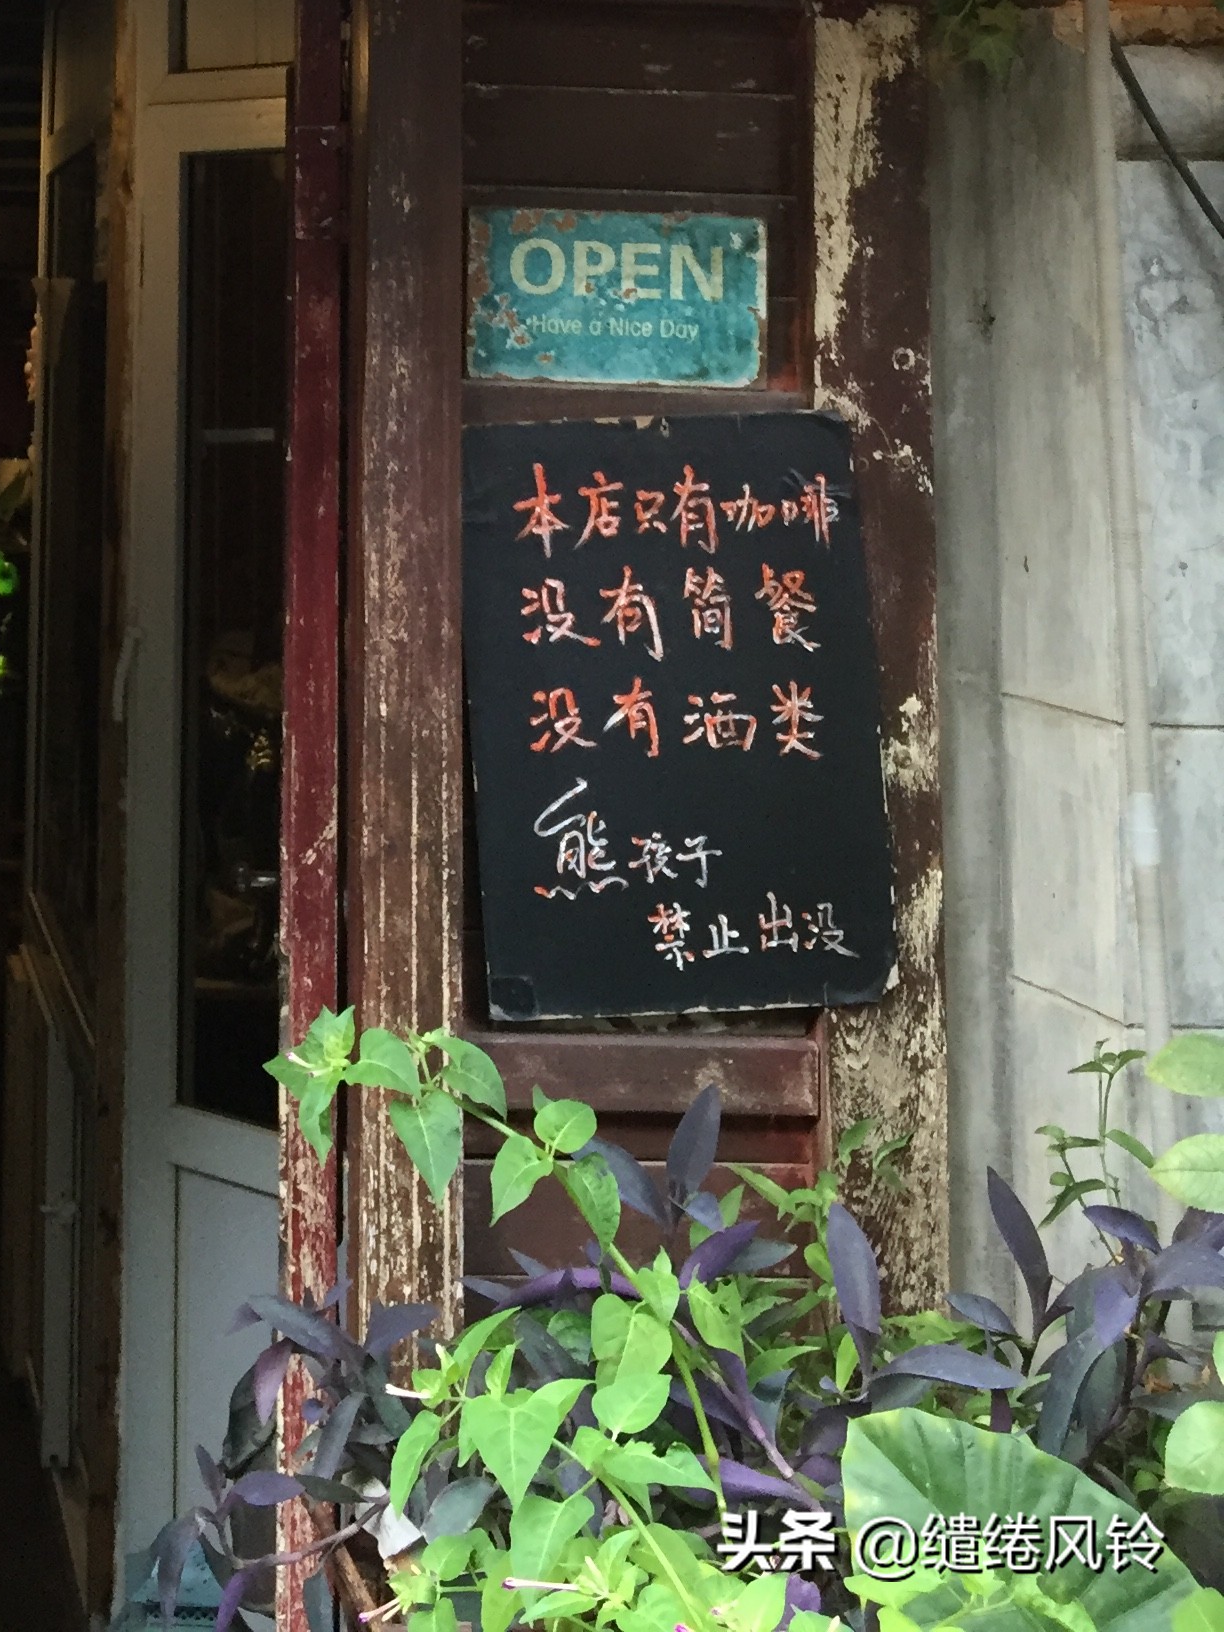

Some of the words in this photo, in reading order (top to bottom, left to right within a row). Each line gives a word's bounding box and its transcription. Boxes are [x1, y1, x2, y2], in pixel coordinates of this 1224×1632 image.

[509, 238, 724, 301] OPEN
[532, 314, 582, 336] Have
[589, 320, 602, 336] a
[609, 317, 652, 338] Nice
[659, 319, 699, 342] Day
[513, 462, 840, 558] 本店只有咖啡
[520, 563, 822, 662] 没有简餐
[529, 676, 825, 760] 没有酒类
[533, 777, 724, 901] 熊孩子
[647, 890, 860, 972] 禁止出没
